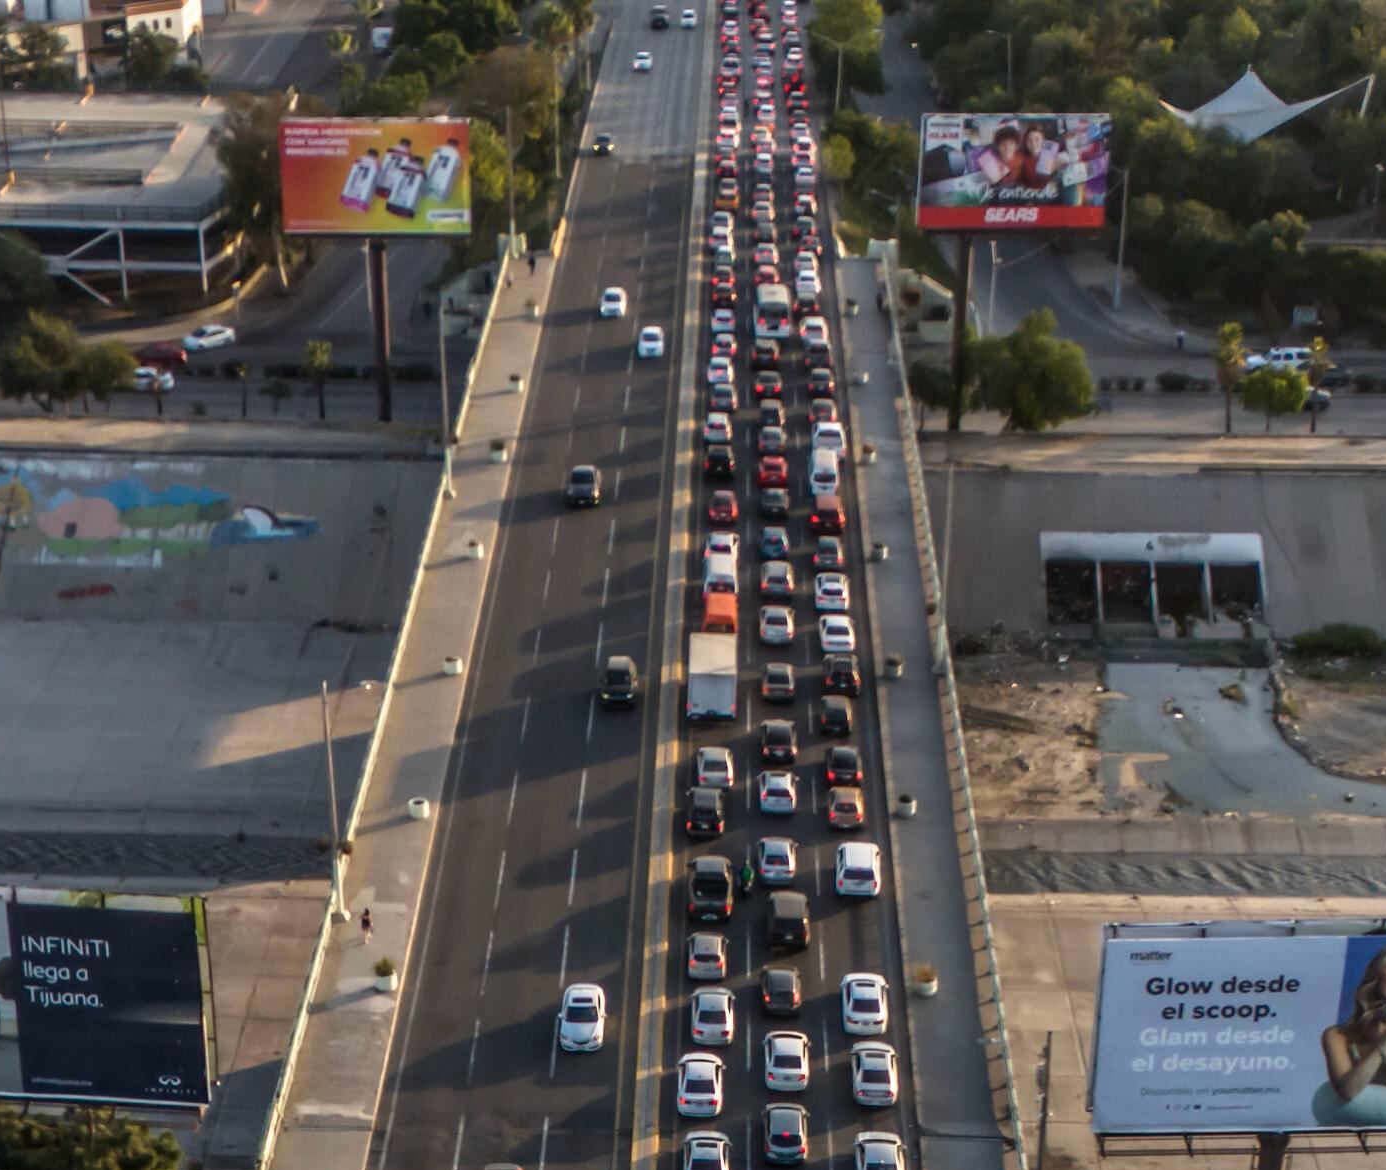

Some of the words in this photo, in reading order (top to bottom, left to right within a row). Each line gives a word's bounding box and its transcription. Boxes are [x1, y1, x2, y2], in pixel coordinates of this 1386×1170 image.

[998, 182, 1059, 200] entiende
[984, 207, 1039, 222] SEARS
[21, 935, 110, 958] INFINITI
[1129, 951, 1173, 962] matter
[23, 960, 70, 984] llega
[76, 968, 89, 982] a
[1145, 976, 1213, 996] Glow
[1221, 974, 1301, 994] desde
[24, 985, 104, 1008] Tijuana.
[1161, 1003, 1185, 1020] el
[1192, 1003, 1277, 1023] scoop.
[1139, 1026, 1209, 1047] Glam
[1215, 1025, 1295, 1045] desde
[1131, 1053, 1155, 1072] el
[1162, 1052, 1296, 1075] desayuno.
